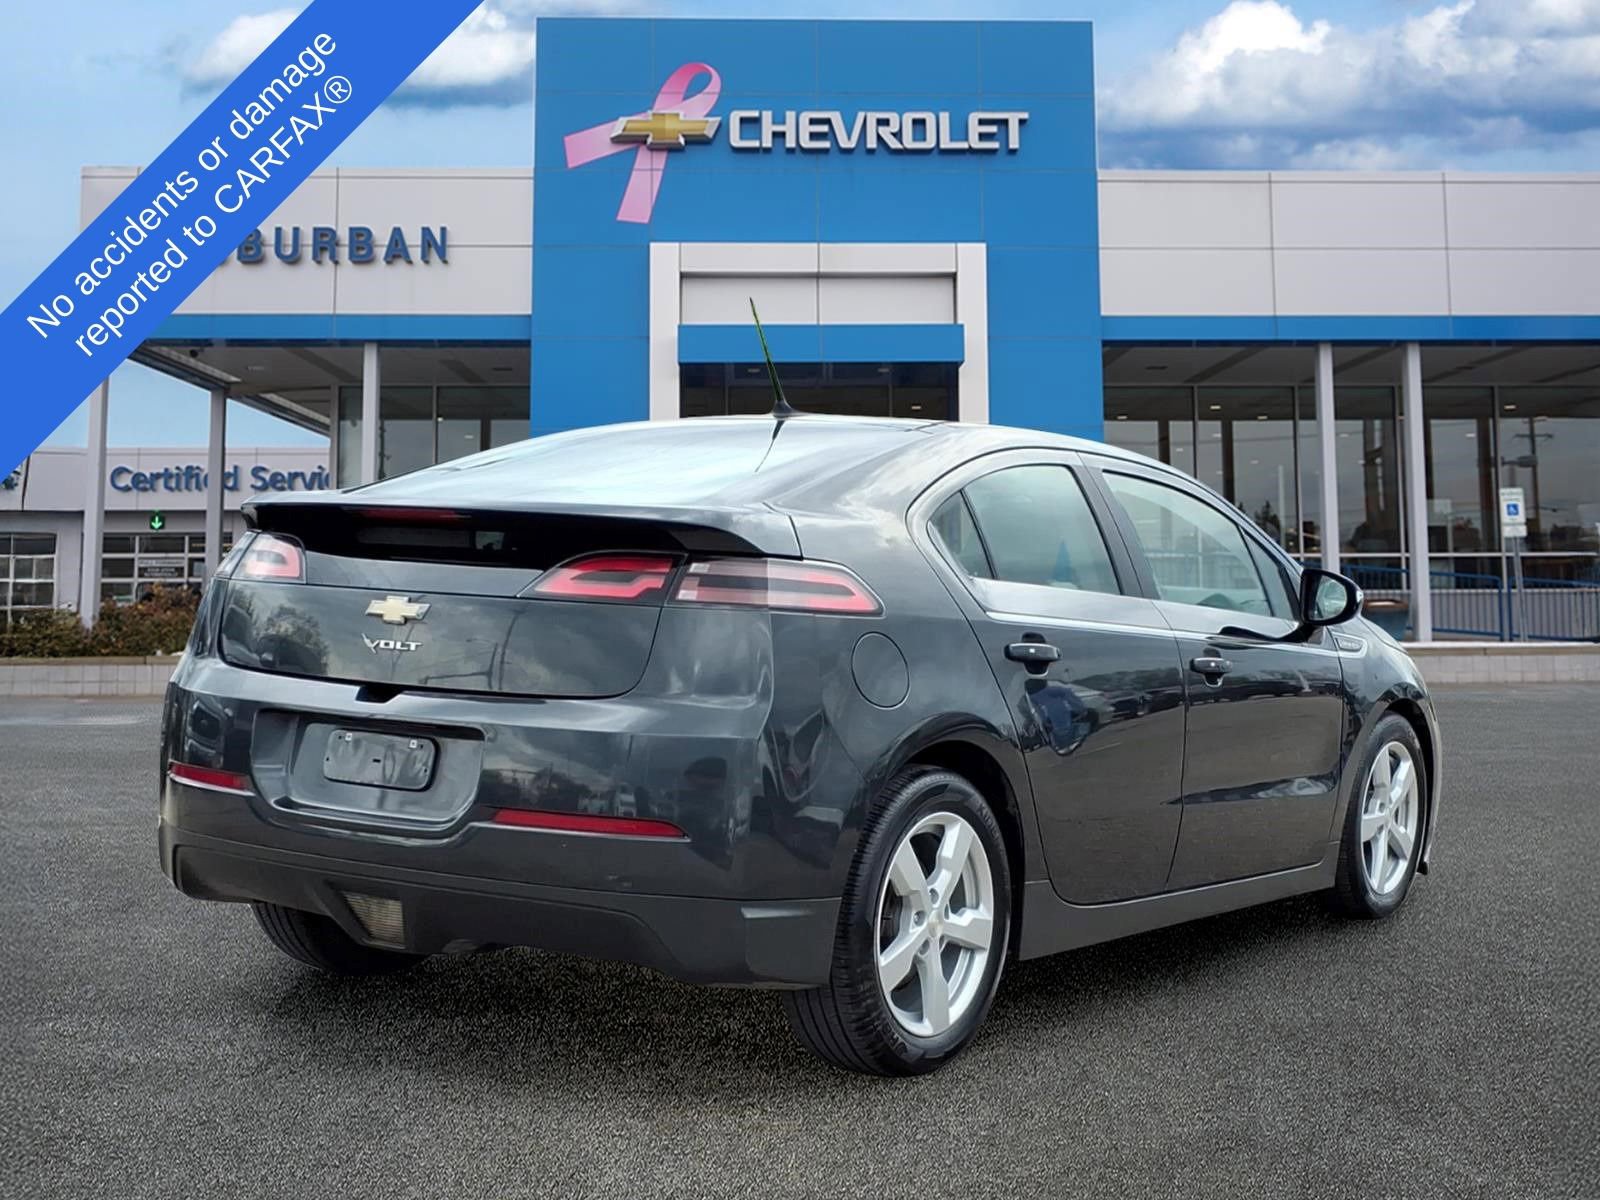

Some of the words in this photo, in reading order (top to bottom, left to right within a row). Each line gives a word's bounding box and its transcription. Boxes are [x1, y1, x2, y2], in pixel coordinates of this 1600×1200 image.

[729, 109, 1029, 150] CHEVROLET
[219, 226, 449, 264] BURBAN
[361, 632, 423, 654] VOLT
